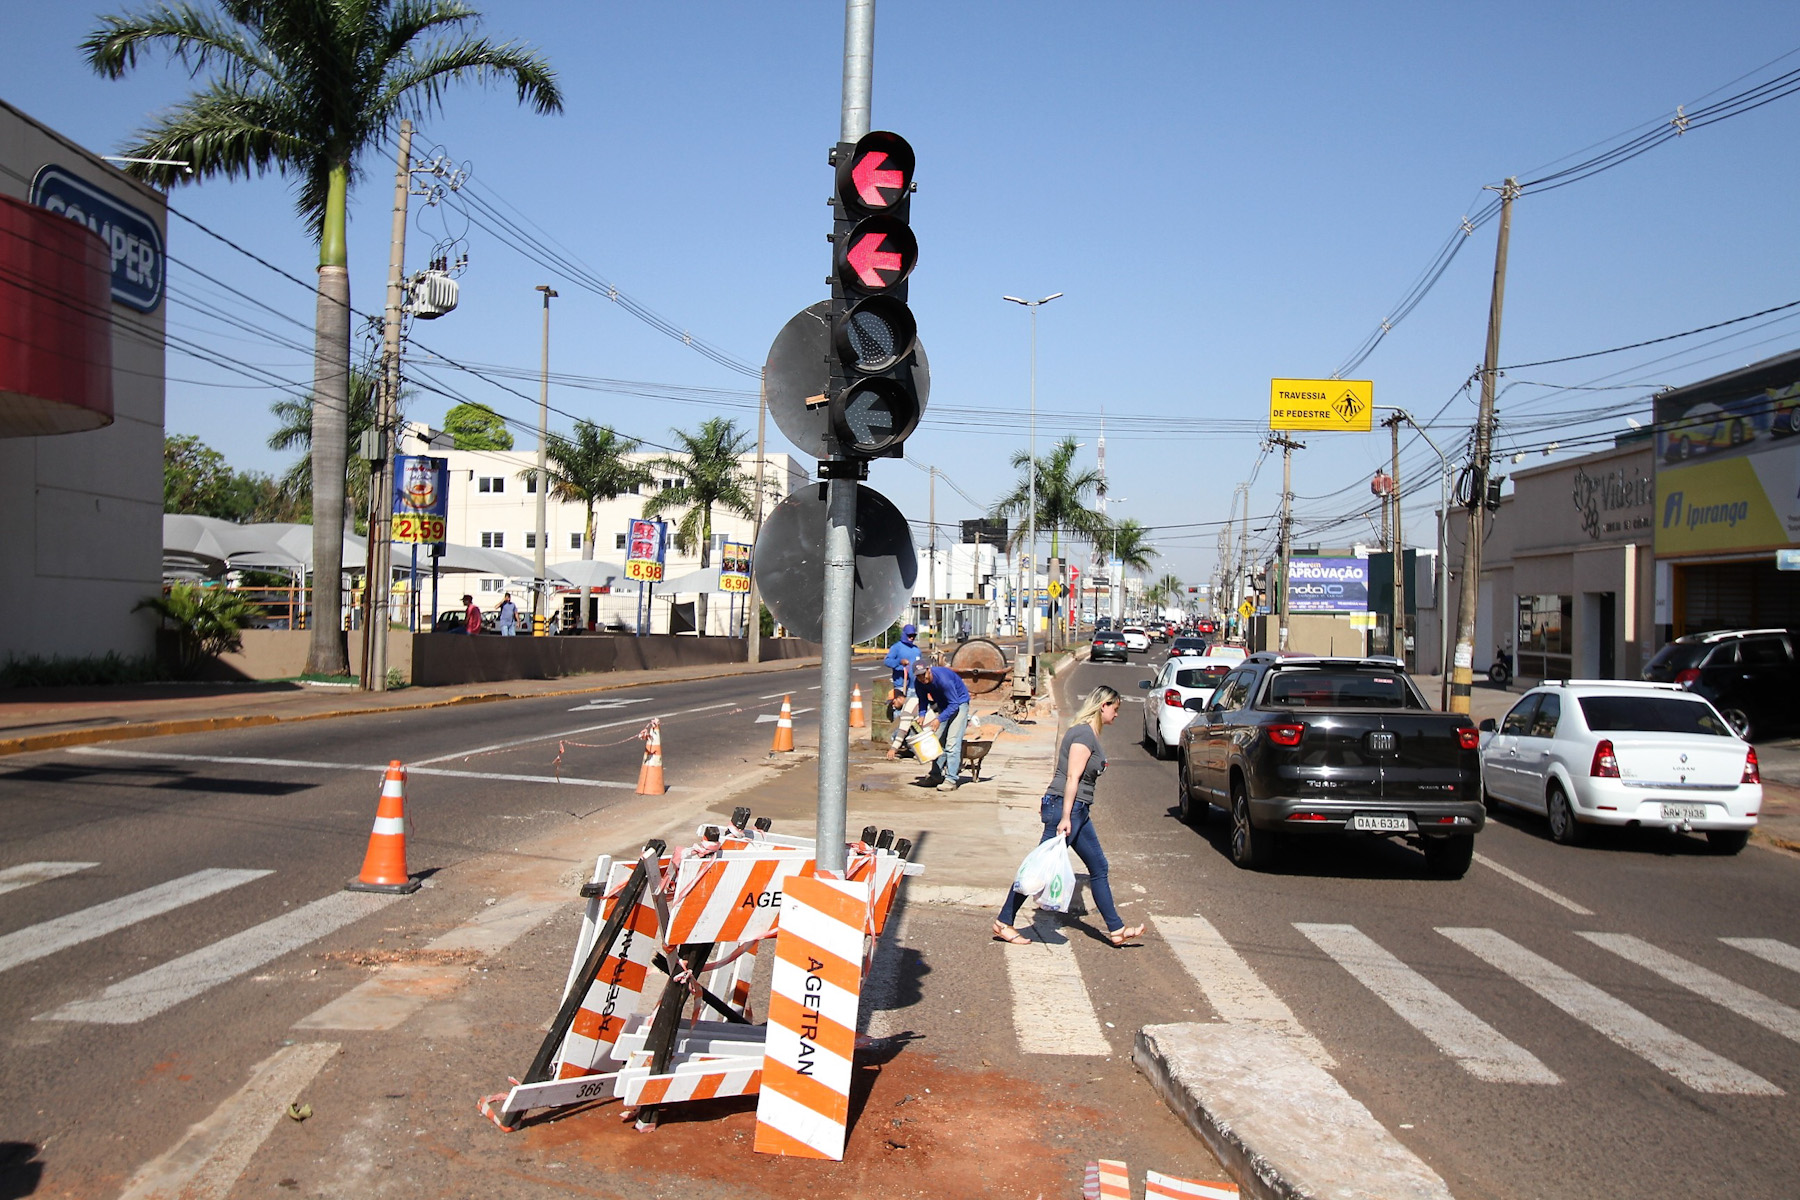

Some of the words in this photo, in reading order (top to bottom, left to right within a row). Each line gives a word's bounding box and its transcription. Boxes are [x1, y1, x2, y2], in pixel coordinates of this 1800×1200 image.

[1279, 391, 1327, 400] TRAVESSIA
[1273, 409, 1284, 417] DE
[1286, 410, 1331, 419] PEDESTRE
[1686, 500, 1749, 532] Ipiranga
[399, 520, 445, 542] 2,59
[632, 563, 662, 580] 8,98
[1288, 566, 1364, 581] APROVAÇÃO
[725, 578, 749, 591] 8,90
[1373, 734, 1392, 749] FIAT
[796, 956, 824, 1077] AGETRAN
[576, 1082, 604, 1098] 366
